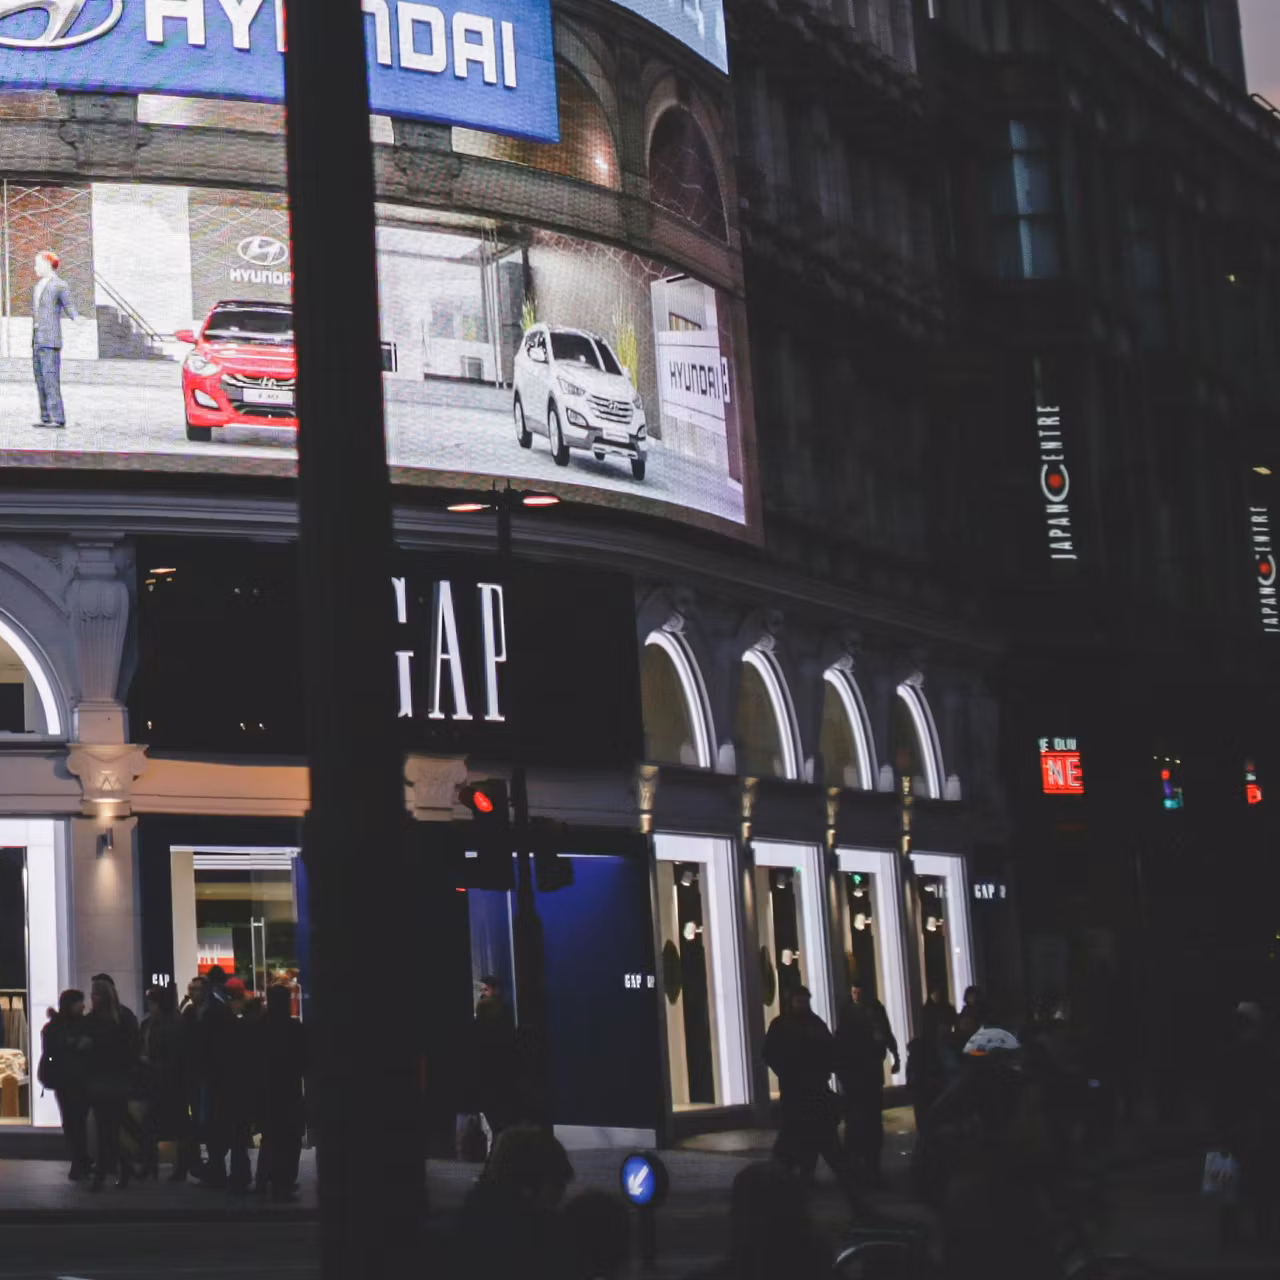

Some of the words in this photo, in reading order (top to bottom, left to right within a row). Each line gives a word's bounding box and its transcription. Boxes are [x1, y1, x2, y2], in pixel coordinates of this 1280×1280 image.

[229, 268, 294, 286] HYUNDA
[668, 360, 721, 400] HYUNDAI
[151, 972, 170, 988] GAP
